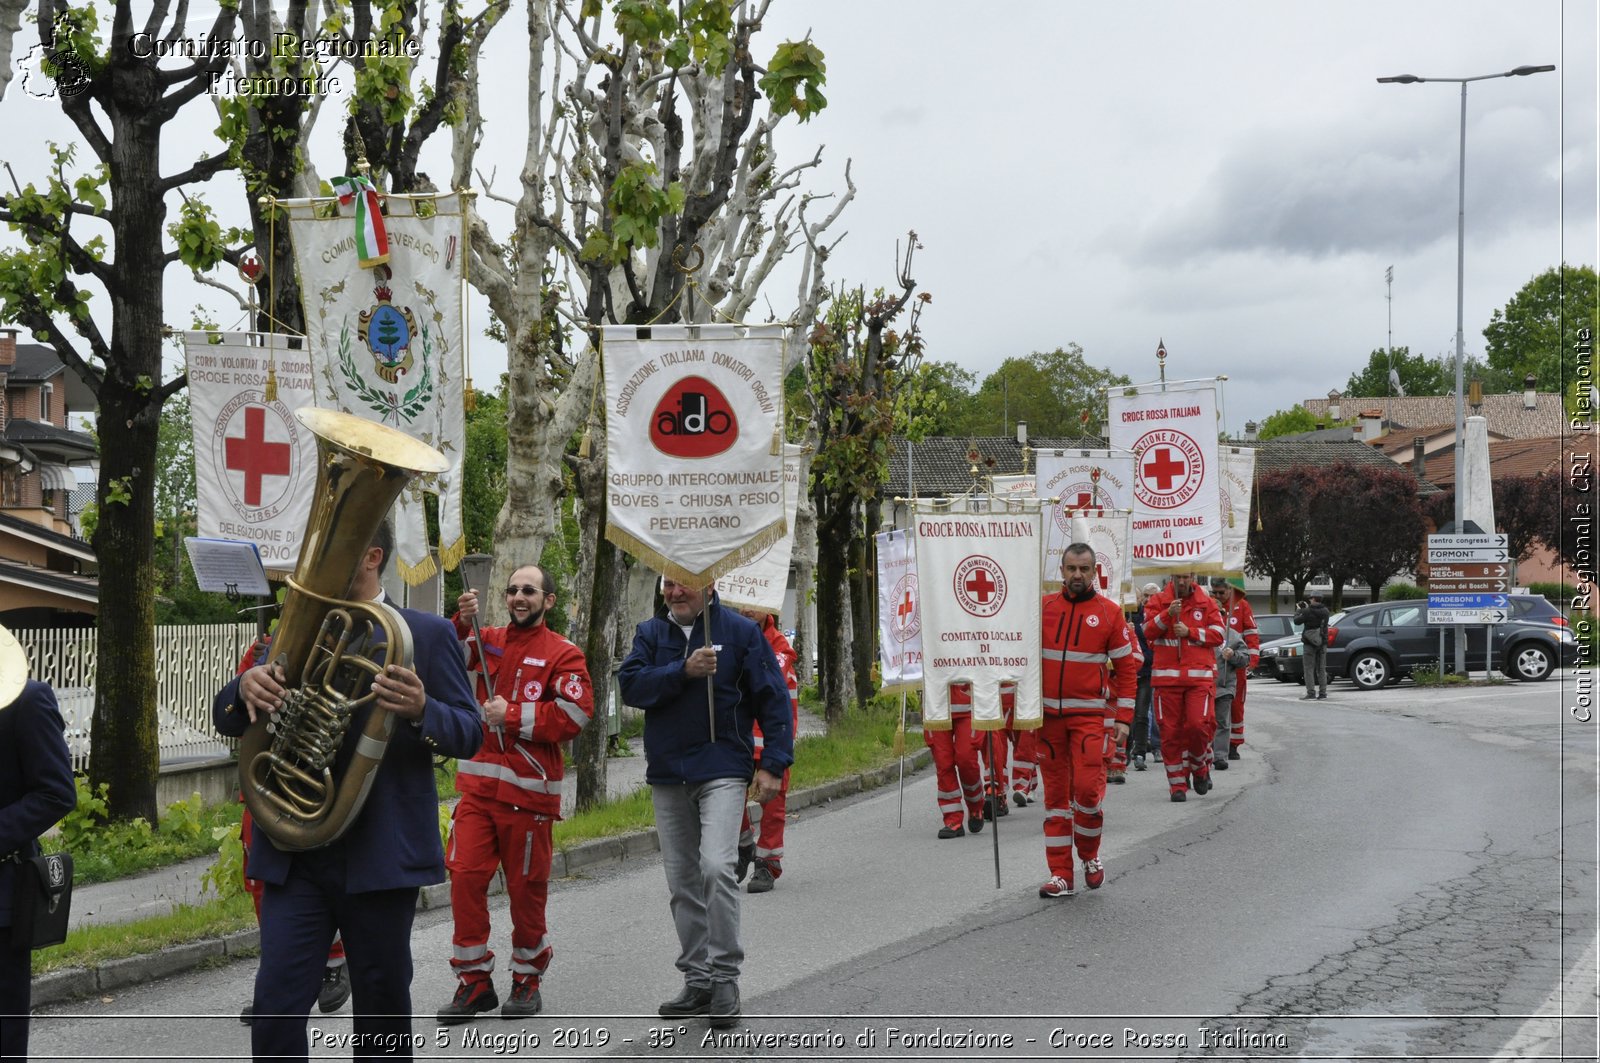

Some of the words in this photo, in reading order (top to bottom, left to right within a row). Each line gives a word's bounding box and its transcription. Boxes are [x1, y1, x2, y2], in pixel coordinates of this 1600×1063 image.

[321, 236, 356, 264] COMUN
[387, 233, 440, 264] EVERAGNO
[190, 370, 230, 384] CROCE
[233, 372, 268, 386] ROSSA
[276, 376, 313, 390] TALIAN
[615, 359, 660, 418] ASSOCIAZIONE
[659, 349, 705, 367] ITALIANA
[711, 351, 755, 382] DONATORI
[751, 380, 776, 414] ORGANI
[216, 391, 256, 438] CONVENZIONE
[657, 393, 732, 435] aido
[1121, 410, 1144, 423] CROCE
[1146, 408, 1168, 421] ROSSA
[1170, 405, 1201, 419] ITALIANA
[1169, 433, 1180, 443] DI
[1180, 439, 1201, 475] GINEVRA
[611, 473, 663, 487] GRUPPO
[668, 470, 779, 486] INTERCOMUNALE
[1046, 470, 1068, 490] CROCE
[1099, 467, 1123, 490] TALIANA
[611, 494, 659, 508] BOVES
[680, 494, 732, 507] CHIUSA
[739, 491, 780, 506] PESIO
[1138, 489, 1148, 500] 22
[1147, 496, 1176, 507] AGOSTO
[1176, 486, 1194, 502] 1864
[650, 515, 741, 530] PEVERAGNO
[919, 521, 952, 538] CROCE
[955, 521, 986, 539] ROSSA
[988, 520, 1033, 538] ITALIANA
[1132, 518, 1171, 530] COMITATO
[1173, 516, 1204, 528] LOCALE
[286, 531, 295, 542] DI
[1163, 530, 1172, 539] di
[1456, 537, 1490, 545] congressi
[1133, 540, 1205, 559] MONDOVI'
[1483, 567, 1489, 575] 8
[1469, 582, 1489, 590] Boschi
[941, 631, 989, 642] COMITATO
[990, 631, 1023, 641] LOCALE
[980, 644, 990, 653] DI
[933, 656, 987, 668] SOMMARIVA
[989, 656, 1002, 666] DEL
